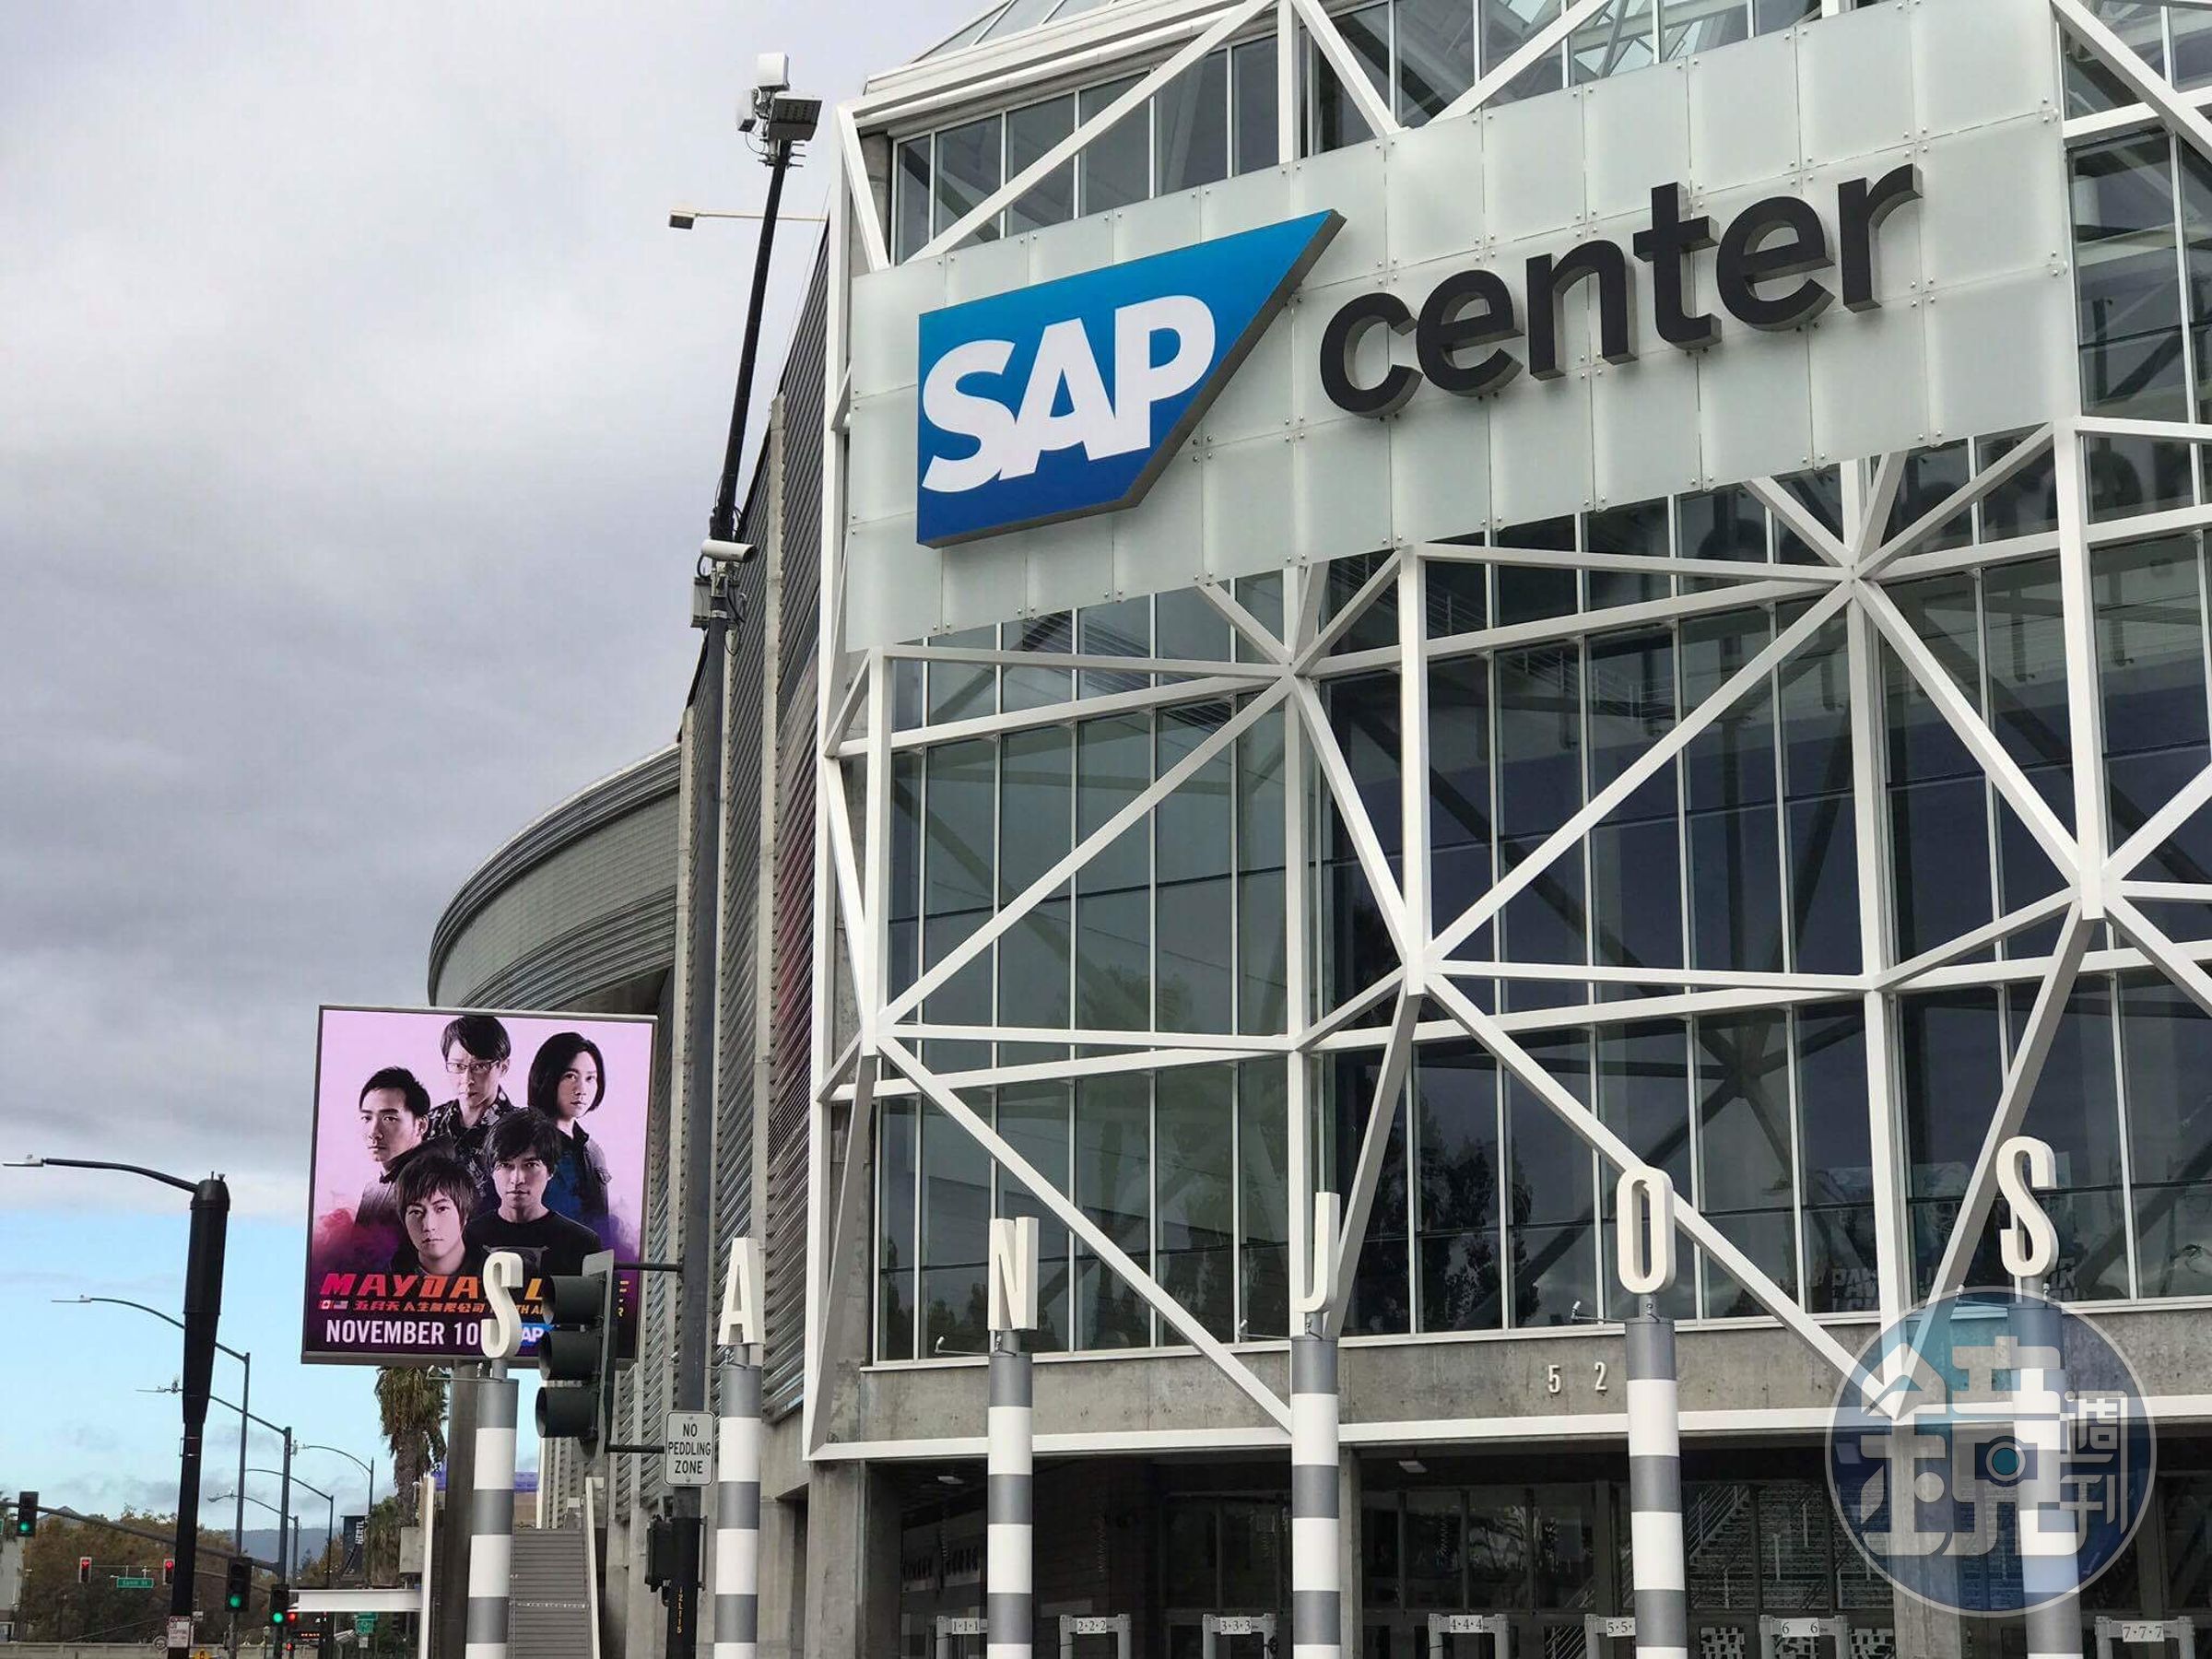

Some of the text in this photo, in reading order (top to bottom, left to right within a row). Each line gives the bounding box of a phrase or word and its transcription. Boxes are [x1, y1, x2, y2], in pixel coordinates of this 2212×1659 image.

[922, 164, 1923, 493] SAP center
[320, 1273, 489, 1300] MAYDA
[325, 1319, 478, 1346] NOVEMBER 10
[521, 1326, 544, 1343] AP
[682, 1423, 698, 1437] NO
[667, 1441, 712, 1456] PEDDLING
[674, 1460, 703, 1474] ZONE
